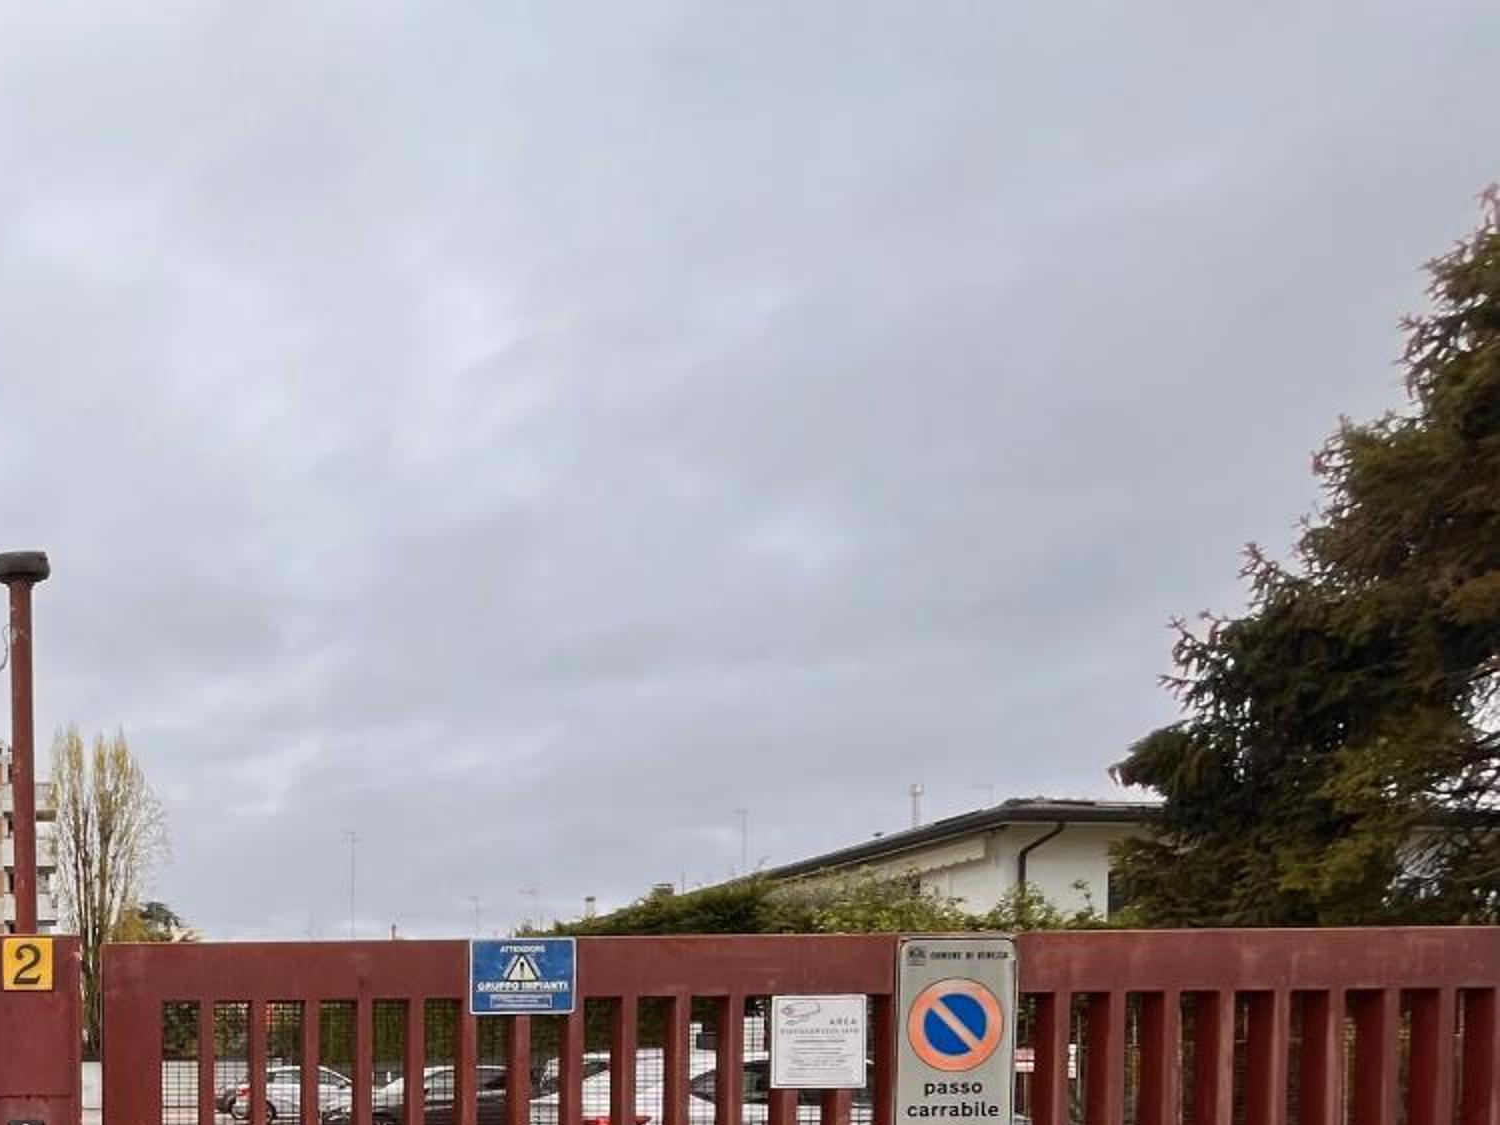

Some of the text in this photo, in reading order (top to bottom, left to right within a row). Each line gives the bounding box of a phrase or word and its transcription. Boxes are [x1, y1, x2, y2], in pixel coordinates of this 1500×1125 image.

[930, 952, 961, 960] COMUNE
[13, 943, 42, 985] 2
[477, 981, 568, 991] GRUPPO IMPIANTI
[924, 1082, 984, 1097] passo
[907, 1101, 1000, 1117] carrabile
